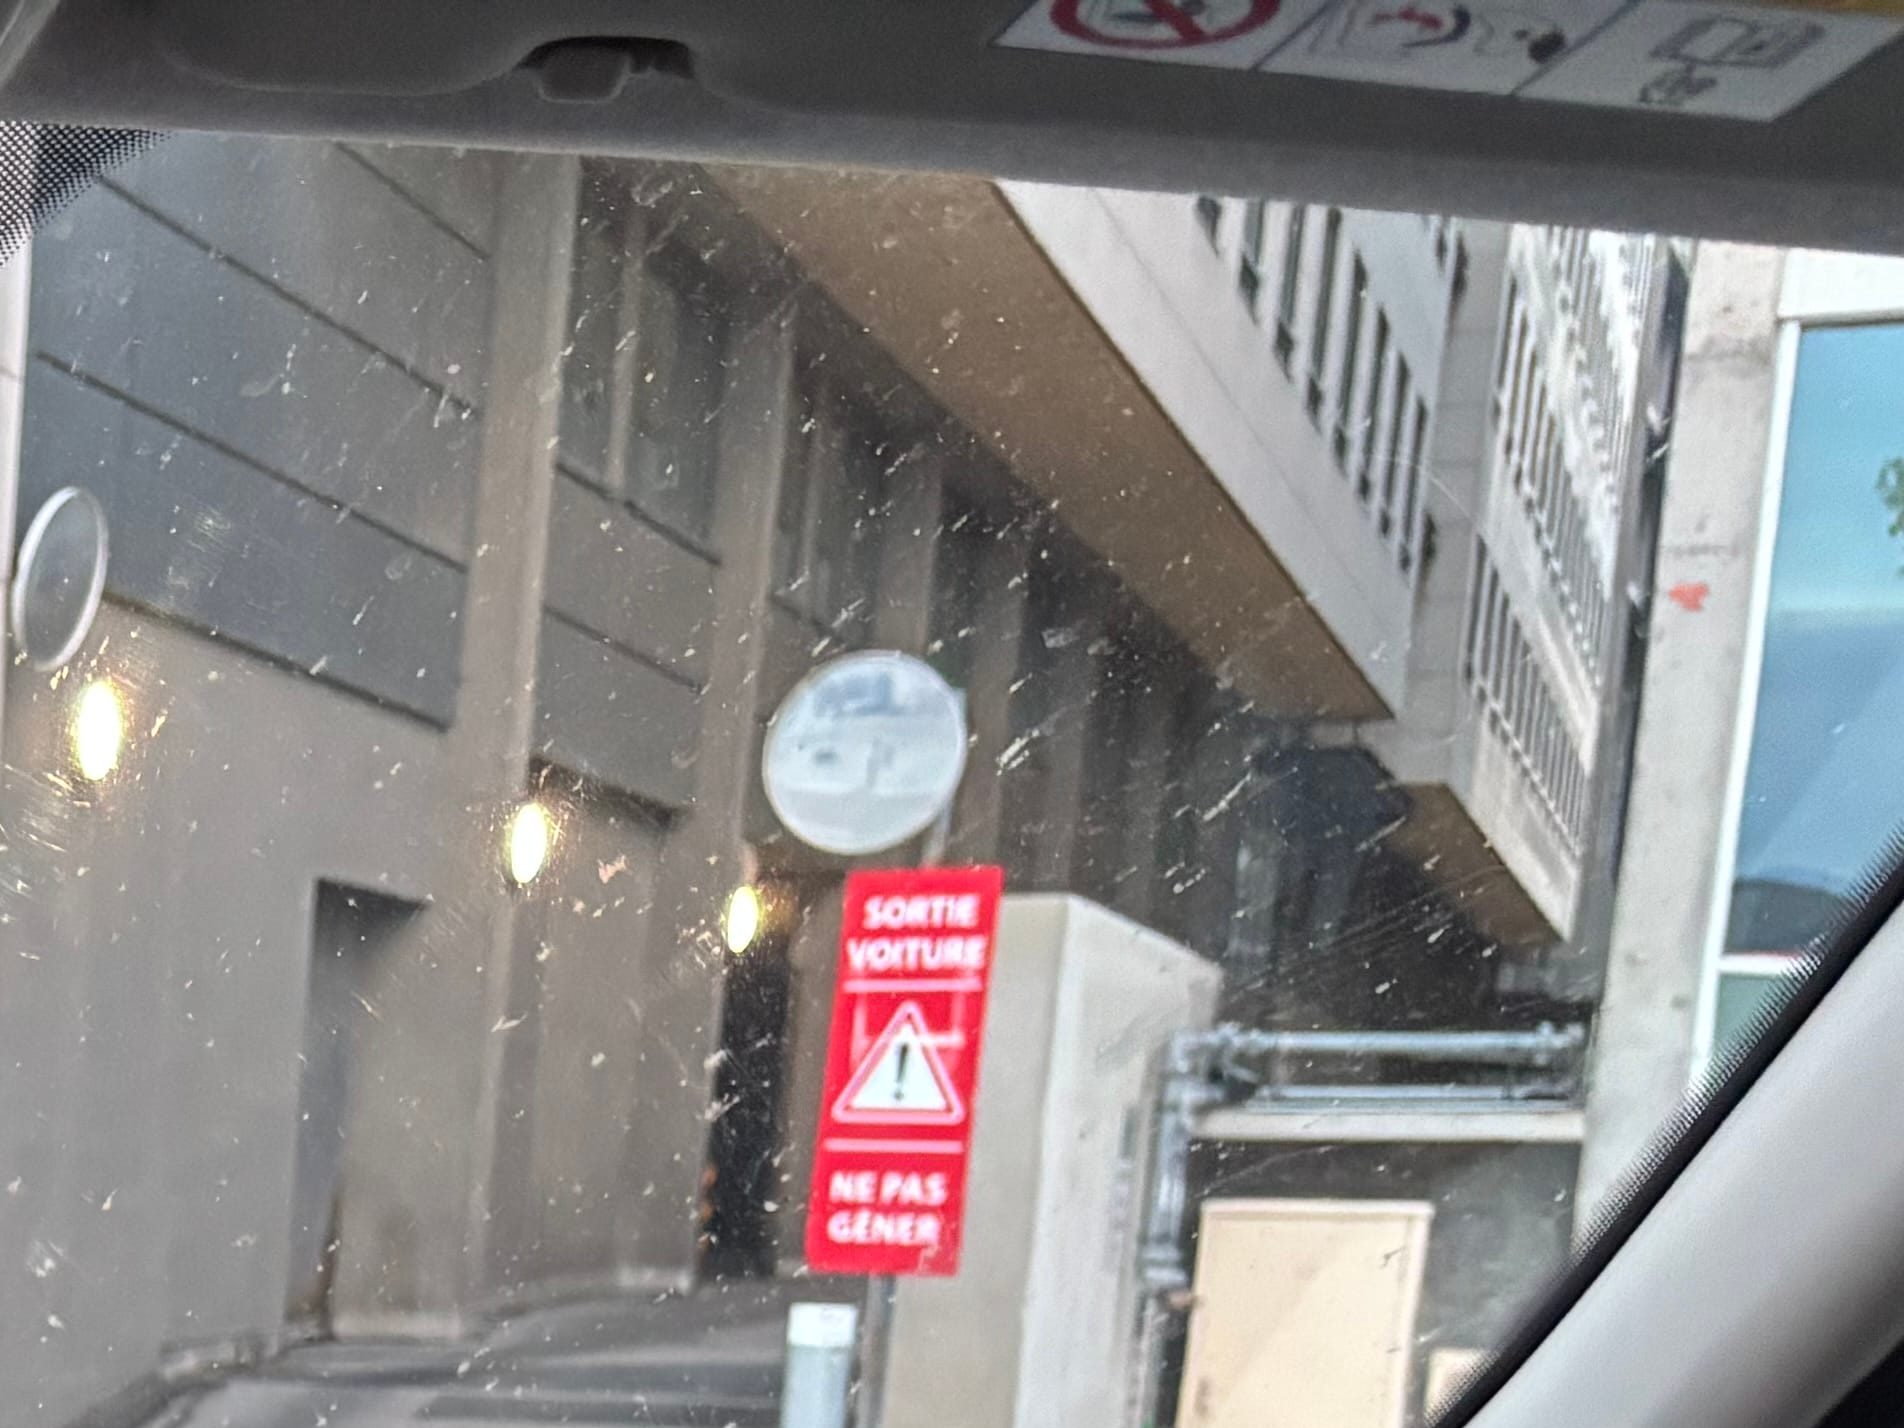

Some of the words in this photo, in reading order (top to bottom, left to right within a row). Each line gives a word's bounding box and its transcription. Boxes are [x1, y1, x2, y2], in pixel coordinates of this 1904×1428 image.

[863, 894, 979, 930] SORTIE
[846, 936, 984, 974] VOITURE
[829, 1170, 875, 1204] NE
[880, 1171, 948, 1206] PAS
